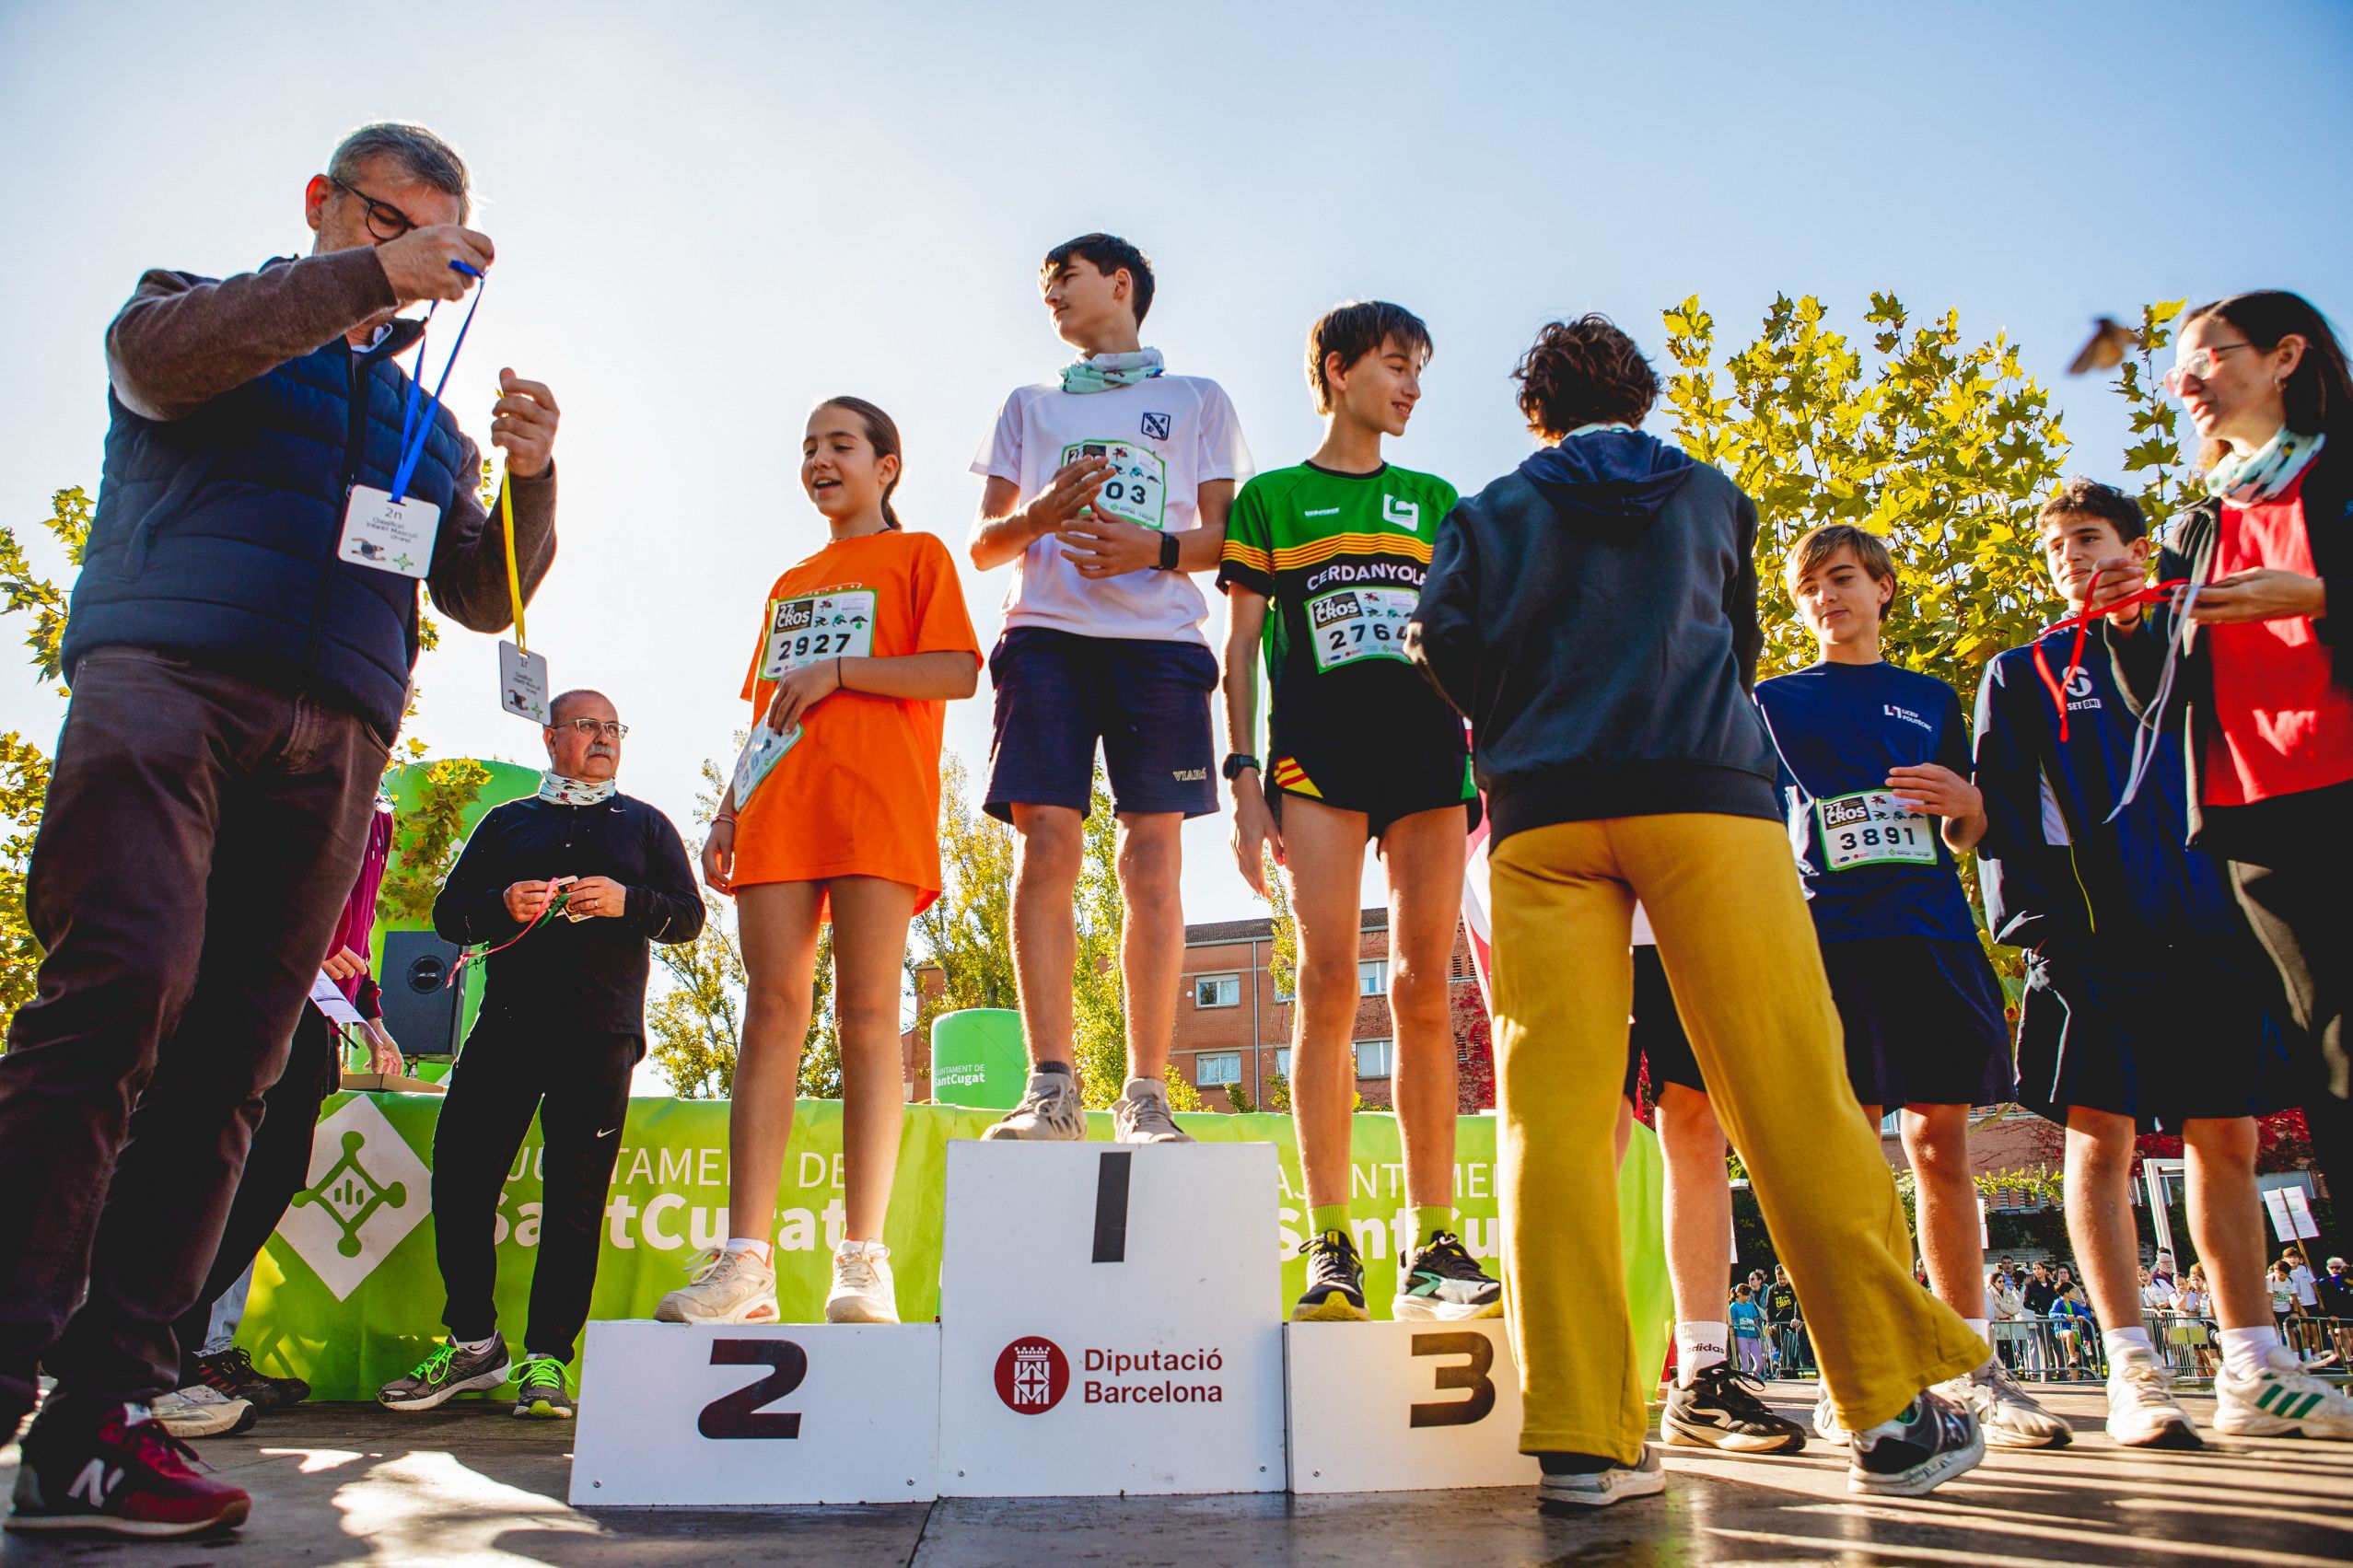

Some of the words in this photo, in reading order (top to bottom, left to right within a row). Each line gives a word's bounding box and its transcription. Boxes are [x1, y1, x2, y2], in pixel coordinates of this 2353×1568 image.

[1105, 482, 1146, 505] 03
[385, 507, 402, 520] 2n
[777, 610, 810, 628] CROS
[1316, 601, 1358, 622] CROS
[778, 633, 851, 660] 2927
[2067, 702, 2082, 711] SET
[2083, 699, 2102, 709] ONE
[1826, 807, 1867, 825] CROS
[1840, 827, 1915, 850] 3891
[974, 1063, 984, 1072] DE
[1092, 1152, 1132, 1263] 1
[1686, 1343, 1724, 1354] adidas
[1084, 1348, 1223, 1376] Diputació
[697, 1339, 808, 1439] 2
[1410, 1331, 1496, 1428] 3
[1084, 1381, 1223, 1403] Barcelona
